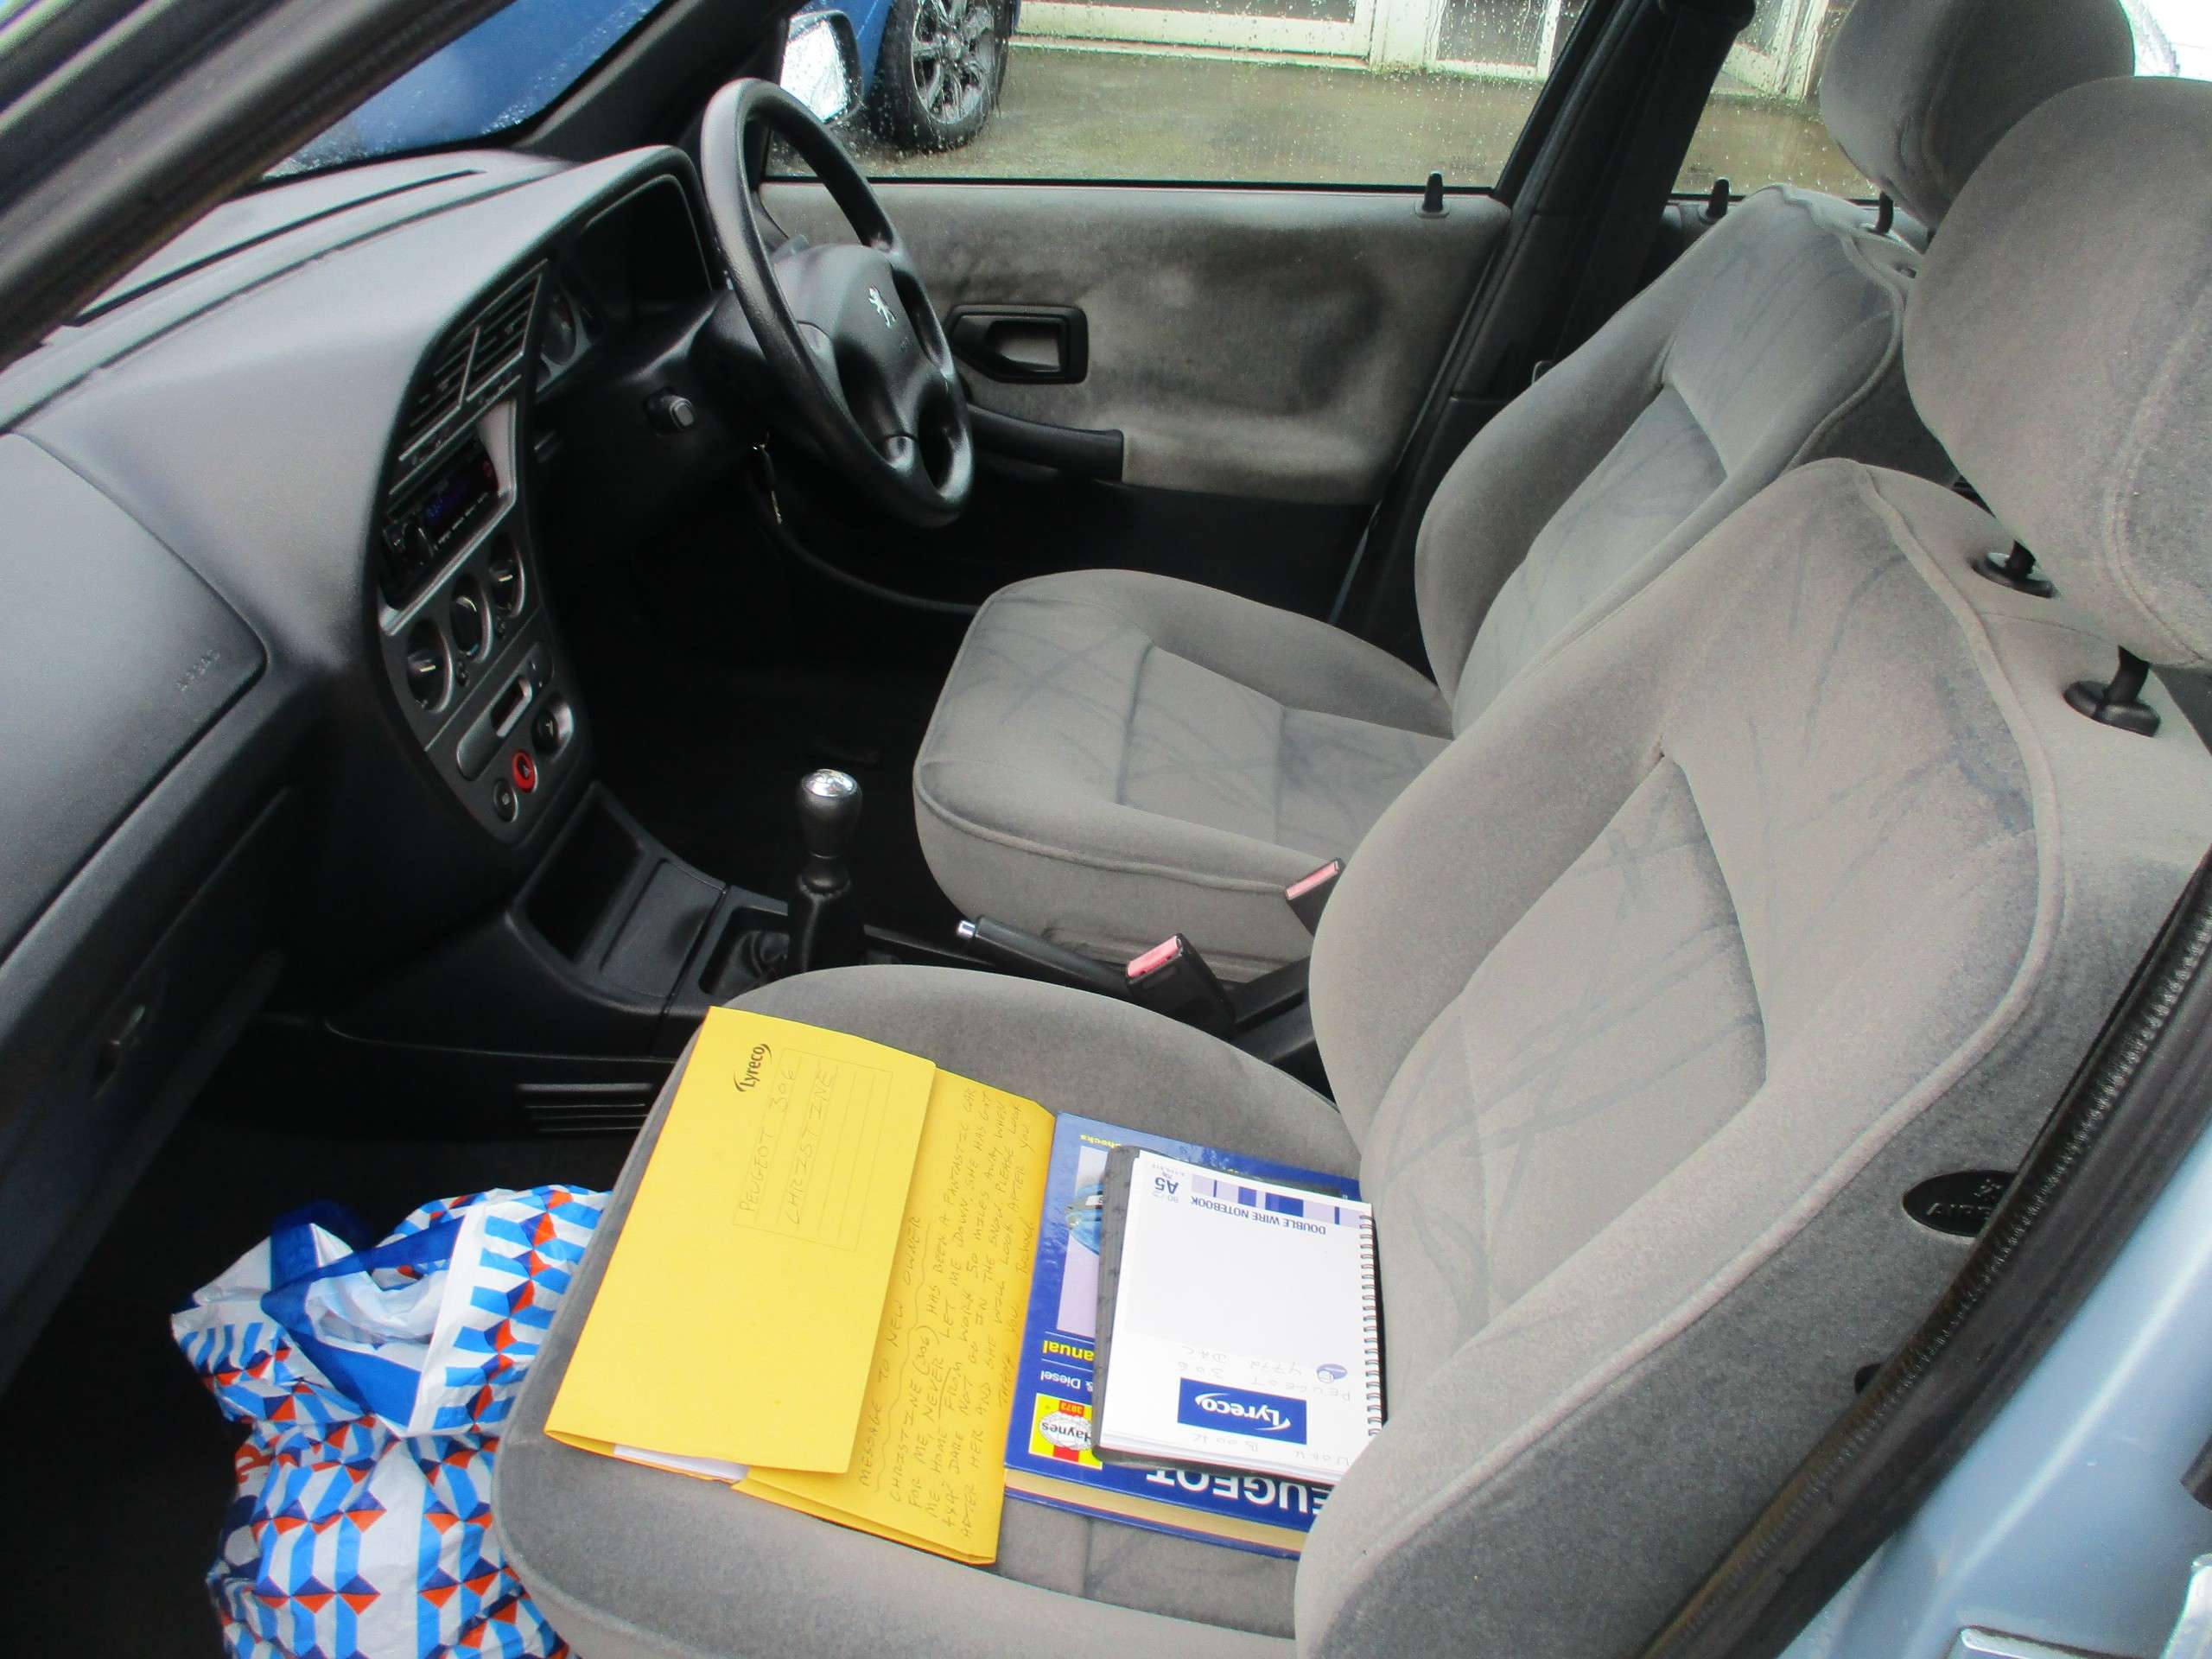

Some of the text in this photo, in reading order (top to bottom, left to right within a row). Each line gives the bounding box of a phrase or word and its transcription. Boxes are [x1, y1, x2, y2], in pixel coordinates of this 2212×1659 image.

[738, 1043, 766, 1090] Lyreco
[961, 1087, 976, 1114] CAR
[992, 1099, 1007, 1139] WHEN
[737, 1067, 798, 1214] PEUGEOT 306
[783, 1069, 836, 1225] CHRISTINE
[970, 1124, 987, 1154] HAS
[941, 1122, 969, 1205] FANTASTIC
[963, 1158, 979, 1191] SHE
[982, 1145, 1005, 1179] AWAY
[995, 1145, 1014, 1192] PLEASE
[1006, 1166, 1026, 1212] AFTER
[1154, 1176, 1179, 1195] A5
[937, 1212, 950, 1226] A
[971, 1190, 991, 1241] MILES
[1191, 1195, 1325, 1235] DOUBLE WIRE NOTEBOOK
[931, 1233, 948, 1273] BEEN
[1000, 1222, 1014, 1265] LOOK
[946, 1258, 963, 1287] ME
[981, 1254, 995, 1285] THE
[922, 1282, 941, 1315] HAS
[938, 1298, 957, 1338] LET
[957, 1290, 976, 1342] WORK
[973, 1296, 988, 1326] IN
[992, 1279, 1006, 1324] WILL
[856, 1215, 922, 1487] MESSAGE TO NEW OWNER
[965, 1340, 980, 1364] GO
[983, 1334, 997, 1370] SHE
[1042, 1339, 1095, 1362] anual
[919, 1354, 945, 1422] NEVER
[942, 1360, 963, 1411] FROM
[957, 1374, 974, 1415] NOT
[974, 1381, 992, 1416] AND
[1039, 1370, 1081, 1389] Diesel
[1175, 1359, 1351, 1402] PEUGEOT 306
[1041, 1421, 1092, 1442] Haynes
[1201, 1396, 1281, 1427] Lyreco
[887, 1377, 923, 1502] CHRISTINE
[930, 1427, 948, 1474] HOME
[947, 1430, 965, 1475] DARE
[967, 1427, 983, 1469] HER
[906, 1474, 924, 1509] FOR
[924, 1489, 941, 1518] ME
[958, 1482, 976, 1539] AFTER
[1147, 1470, 1337, 1516] EUGEOT
